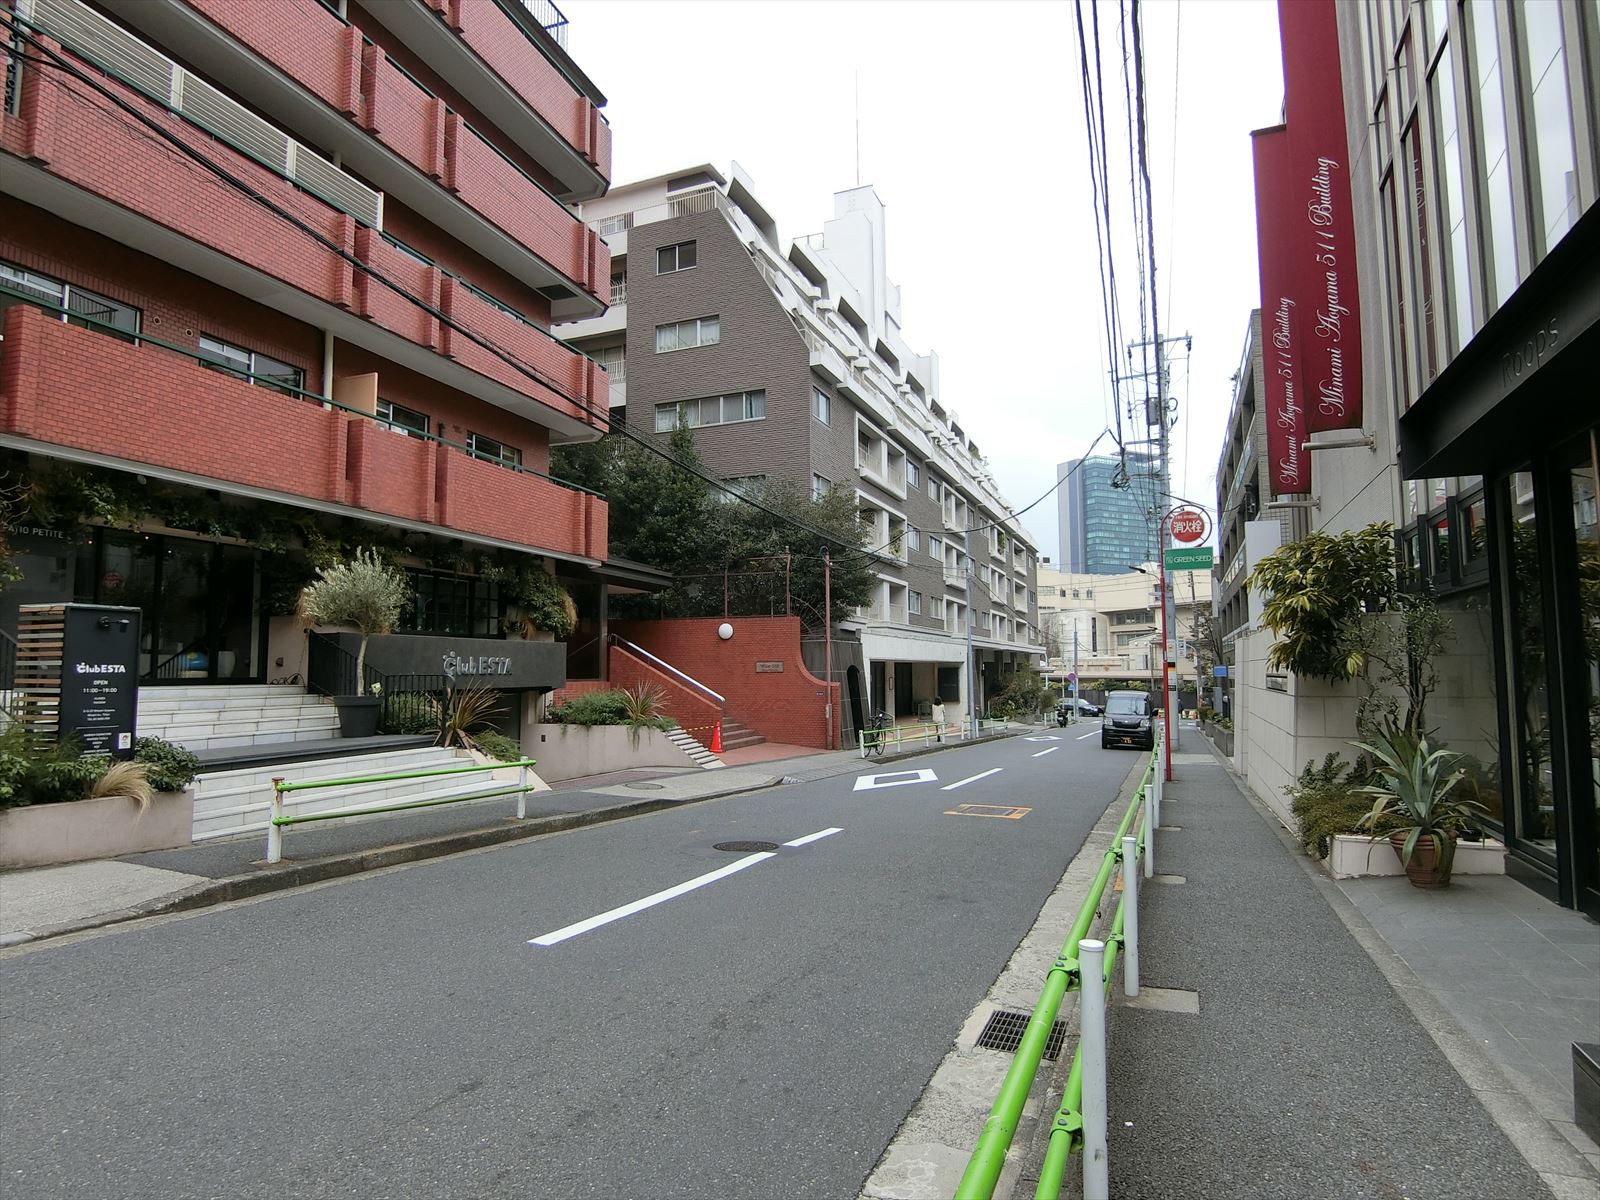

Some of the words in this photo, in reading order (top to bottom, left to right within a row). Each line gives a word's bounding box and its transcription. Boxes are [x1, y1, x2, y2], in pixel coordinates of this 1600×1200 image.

[1308, 156, 1340, 226] Building
[1272, 296, 1296, 349] Building
[1315, 271, 1350, 342] Aoyama
[1277, 380, 1302, 432] Aoyama
[1318, 347, 1345, 417] Minami
[1279, 435, 1298, 486] Minami
[32, 527, 65, 539] PETITE
[1173, 520, 1203, 533] 消火栓
